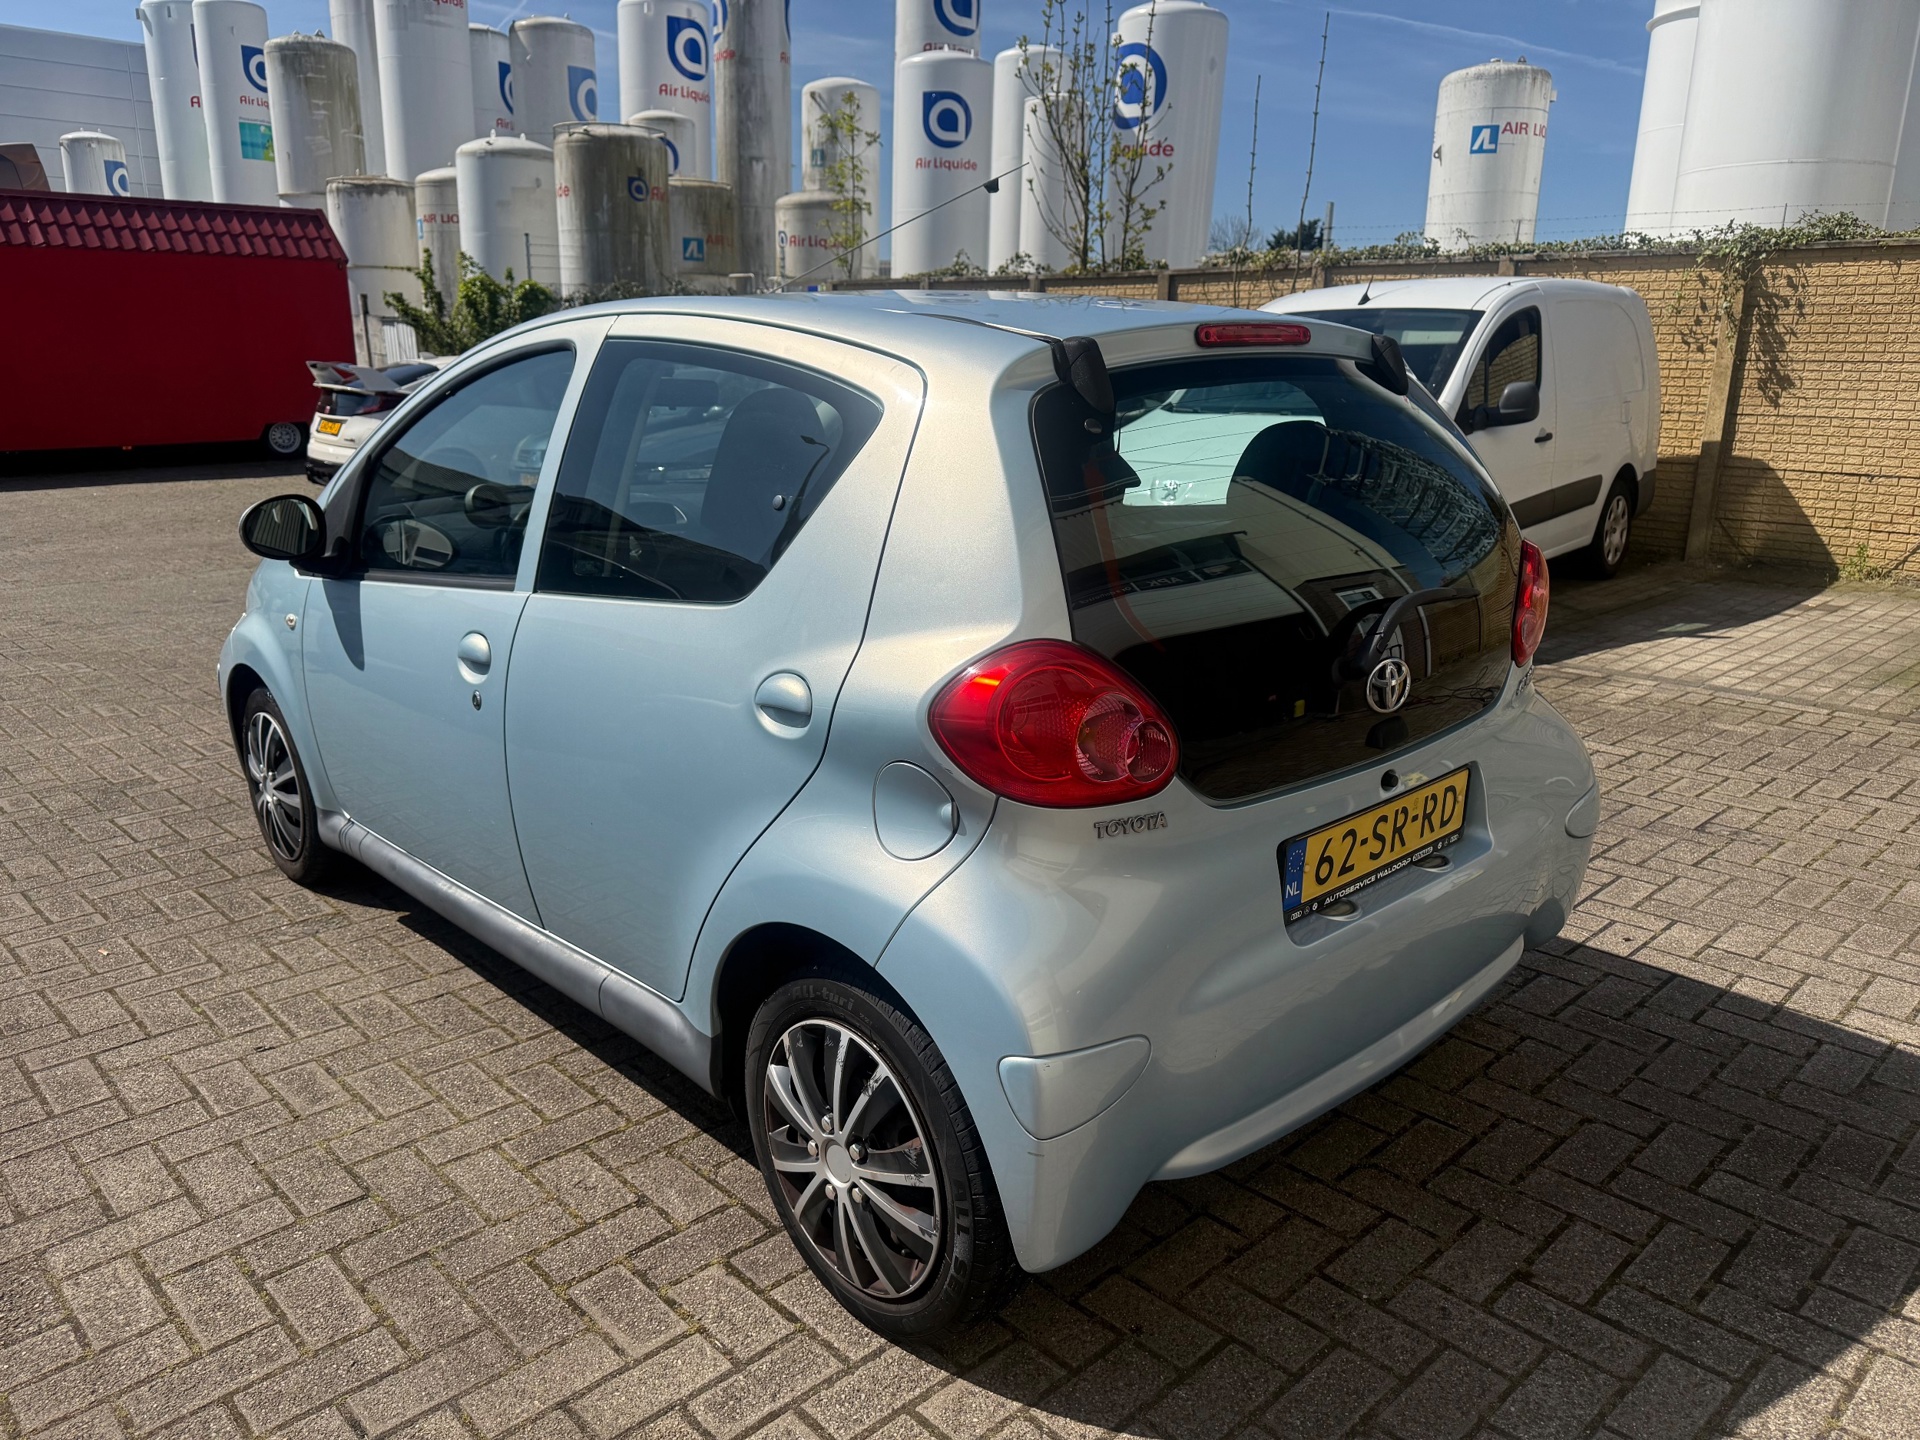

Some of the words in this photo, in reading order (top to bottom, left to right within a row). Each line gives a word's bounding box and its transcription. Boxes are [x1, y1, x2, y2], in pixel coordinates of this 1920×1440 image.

[240, 95, 255, 106] Air
[659, 83, 679, 97] Air
[680, 86, 710, 103] Liquid
[1501, 121, 1529, 135] AIR
[915, 157, 932, 169] Air
[933, 157, 978, 171] Liquide
[789, 235, 806, 247] Air
[1093, 811, 1168, 839] TOYOTA
[1314, 784, 1458, 887] 62-SR-RD
[1285, 881, 1301, 899] NL
[1323, 874, 1376, 905] AUTOSERVICE
[1376, 857, 1412, 879] WALDORP
